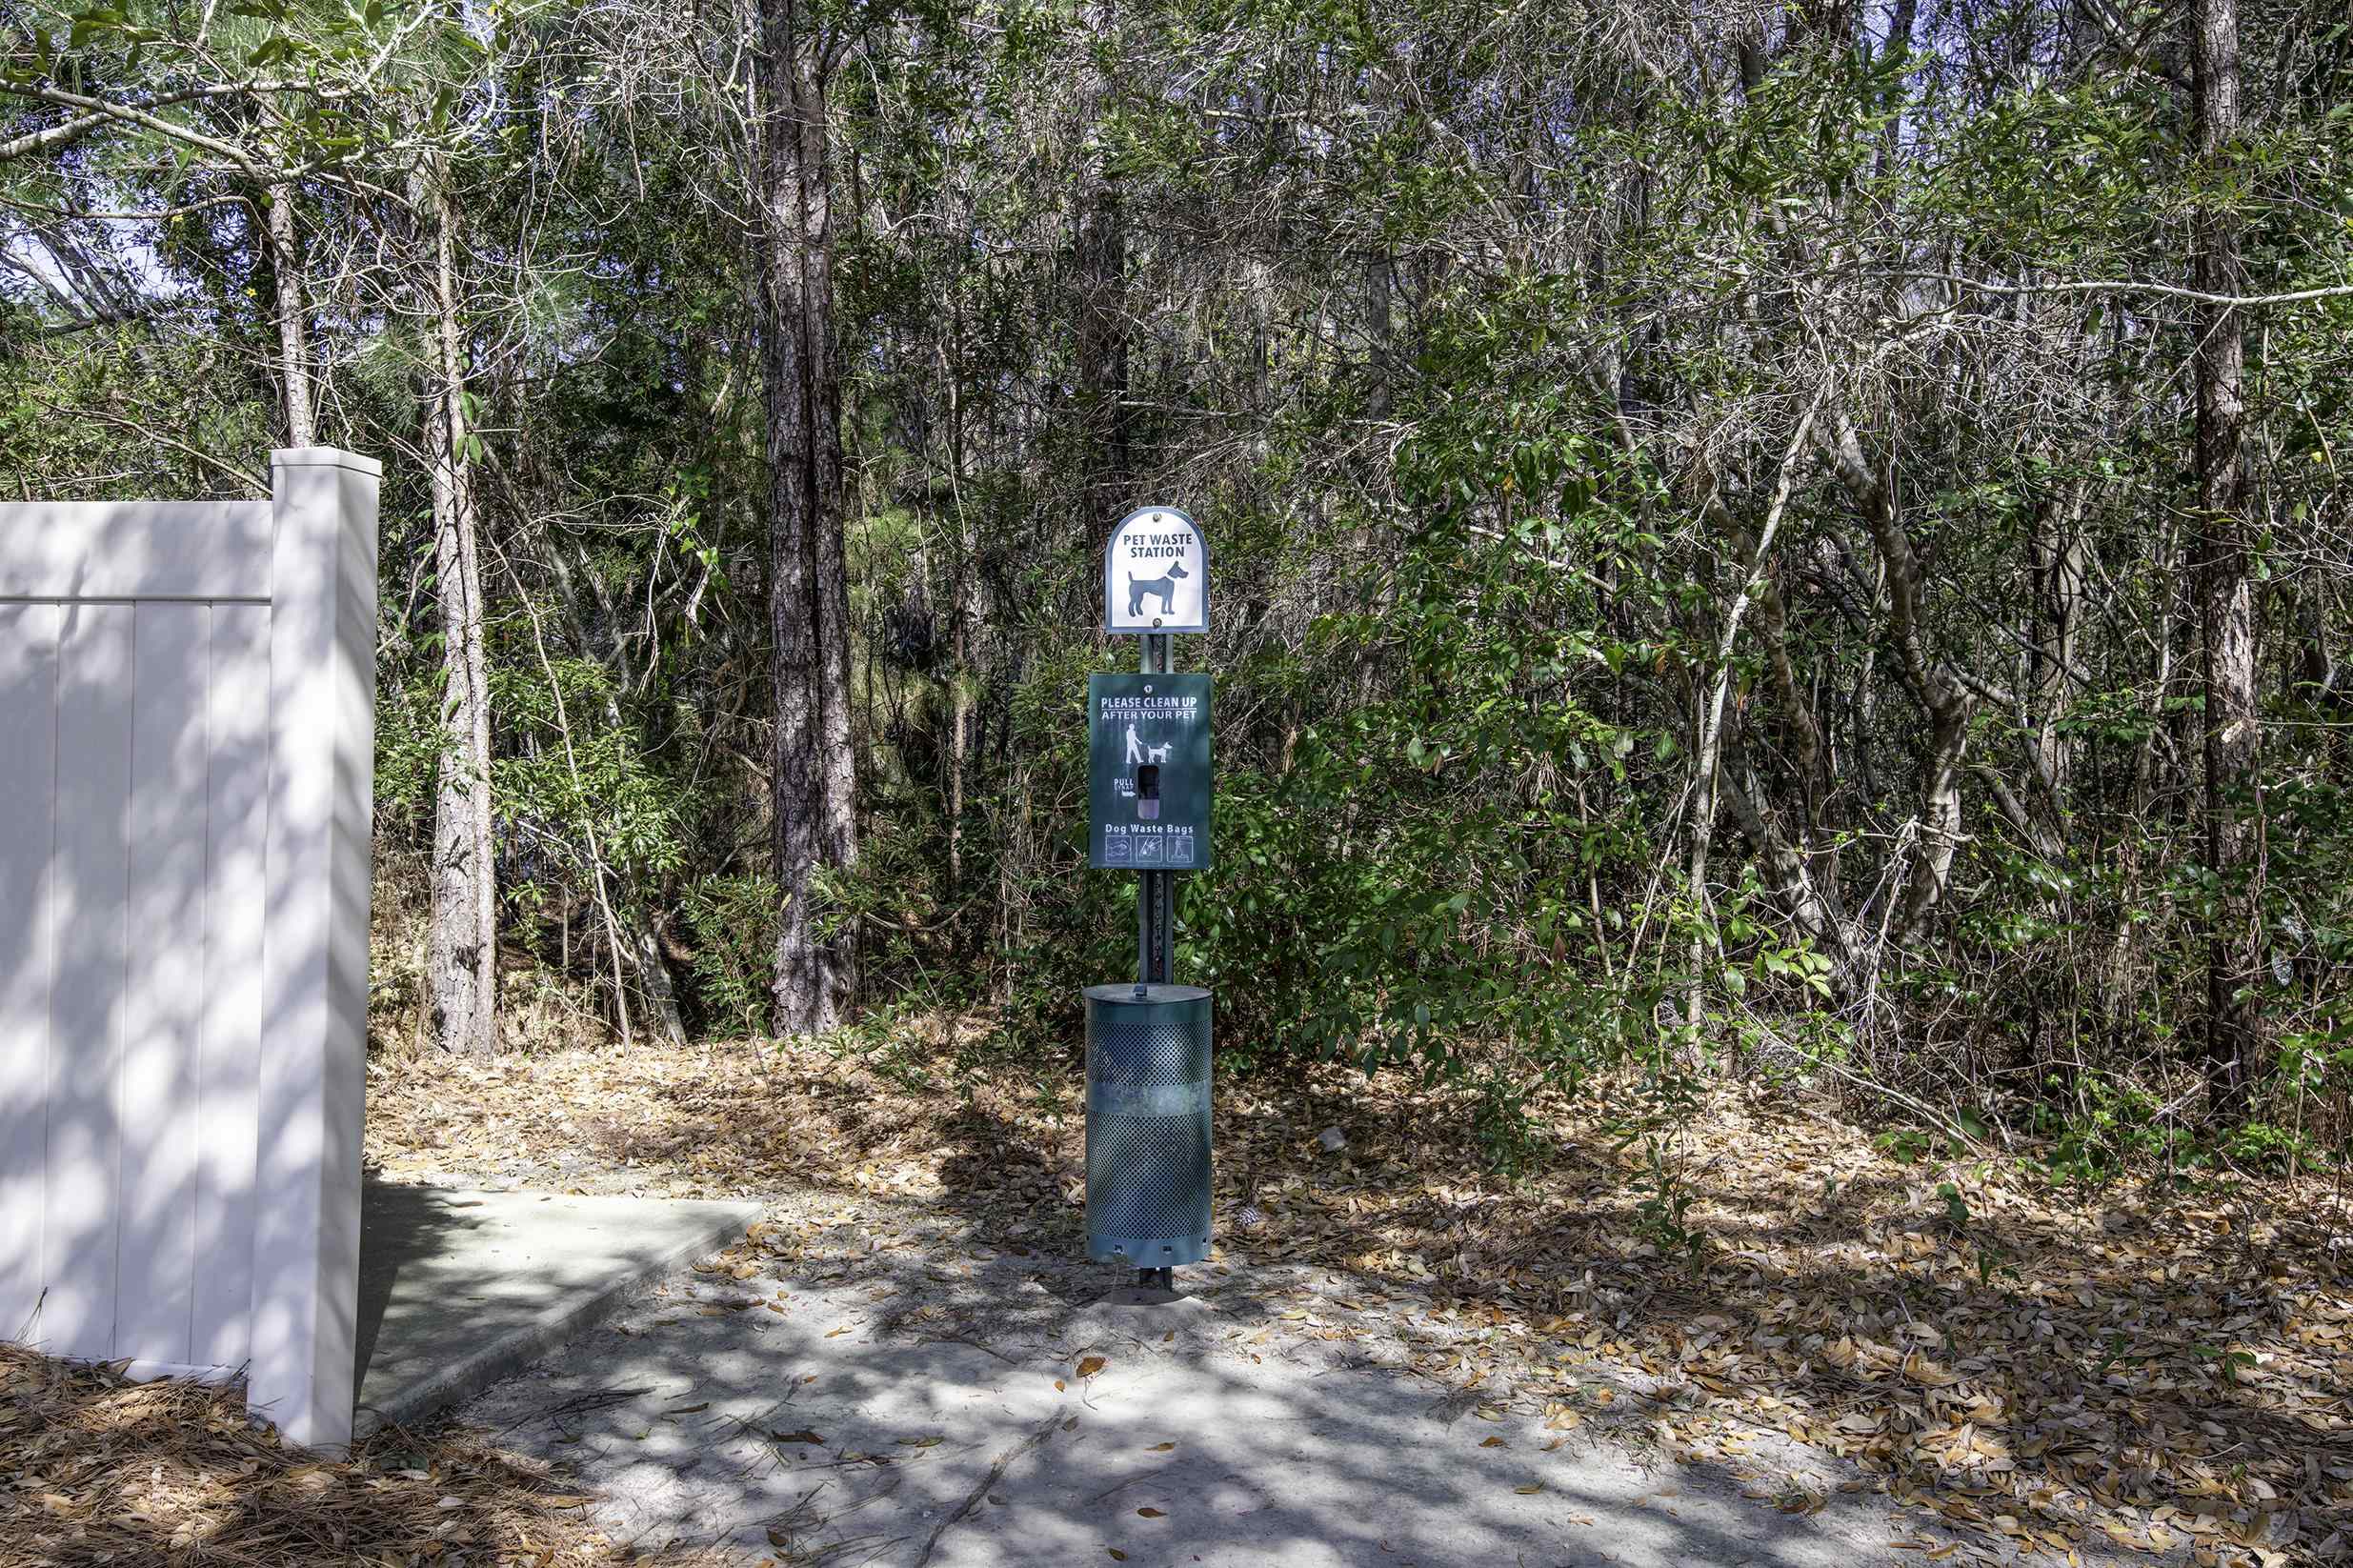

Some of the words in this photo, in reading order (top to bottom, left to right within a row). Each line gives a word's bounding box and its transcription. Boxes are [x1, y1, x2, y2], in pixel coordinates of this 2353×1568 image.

[1123, 534, 1145, 546] PET
[1149, 533, 1193, 545] WASTE
[1130, 546, 1185, 557] STATION
[1101, 697, 1141, 708] PLEASE
[1143, 697, 1178, 708] CLEAN
[1181, 697, 1197, 707] UP
[1101, 711, 1137, 719] AFTER
[1141, 711, 1173, 719] YOUR
[1176, 711, 1197, 719] PET
[1105, 824, 1127, 834] Dog
[1130, 824, 1163, 834] Waste
[1167, 824, 1194, 835] Bags
